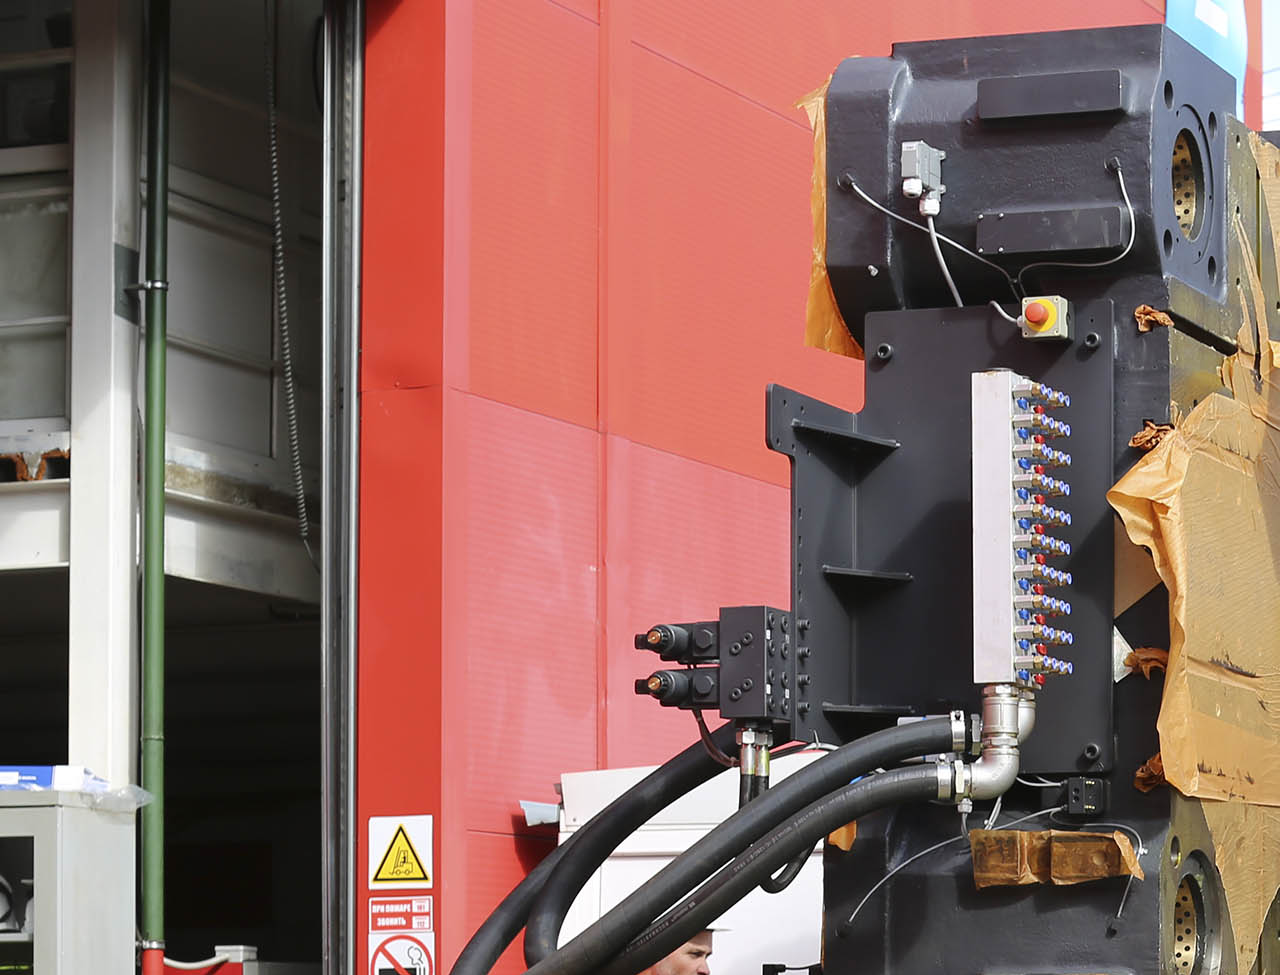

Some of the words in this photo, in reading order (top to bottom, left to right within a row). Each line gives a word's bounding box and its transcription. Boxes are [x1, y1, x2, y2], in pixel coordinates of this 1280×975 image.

[372, 904, 384, 912] ПРИ
[385, 903, 411, 912] ПОЖАРЕ
[377, 917, 406, 926] ЗВОНИТЬ
